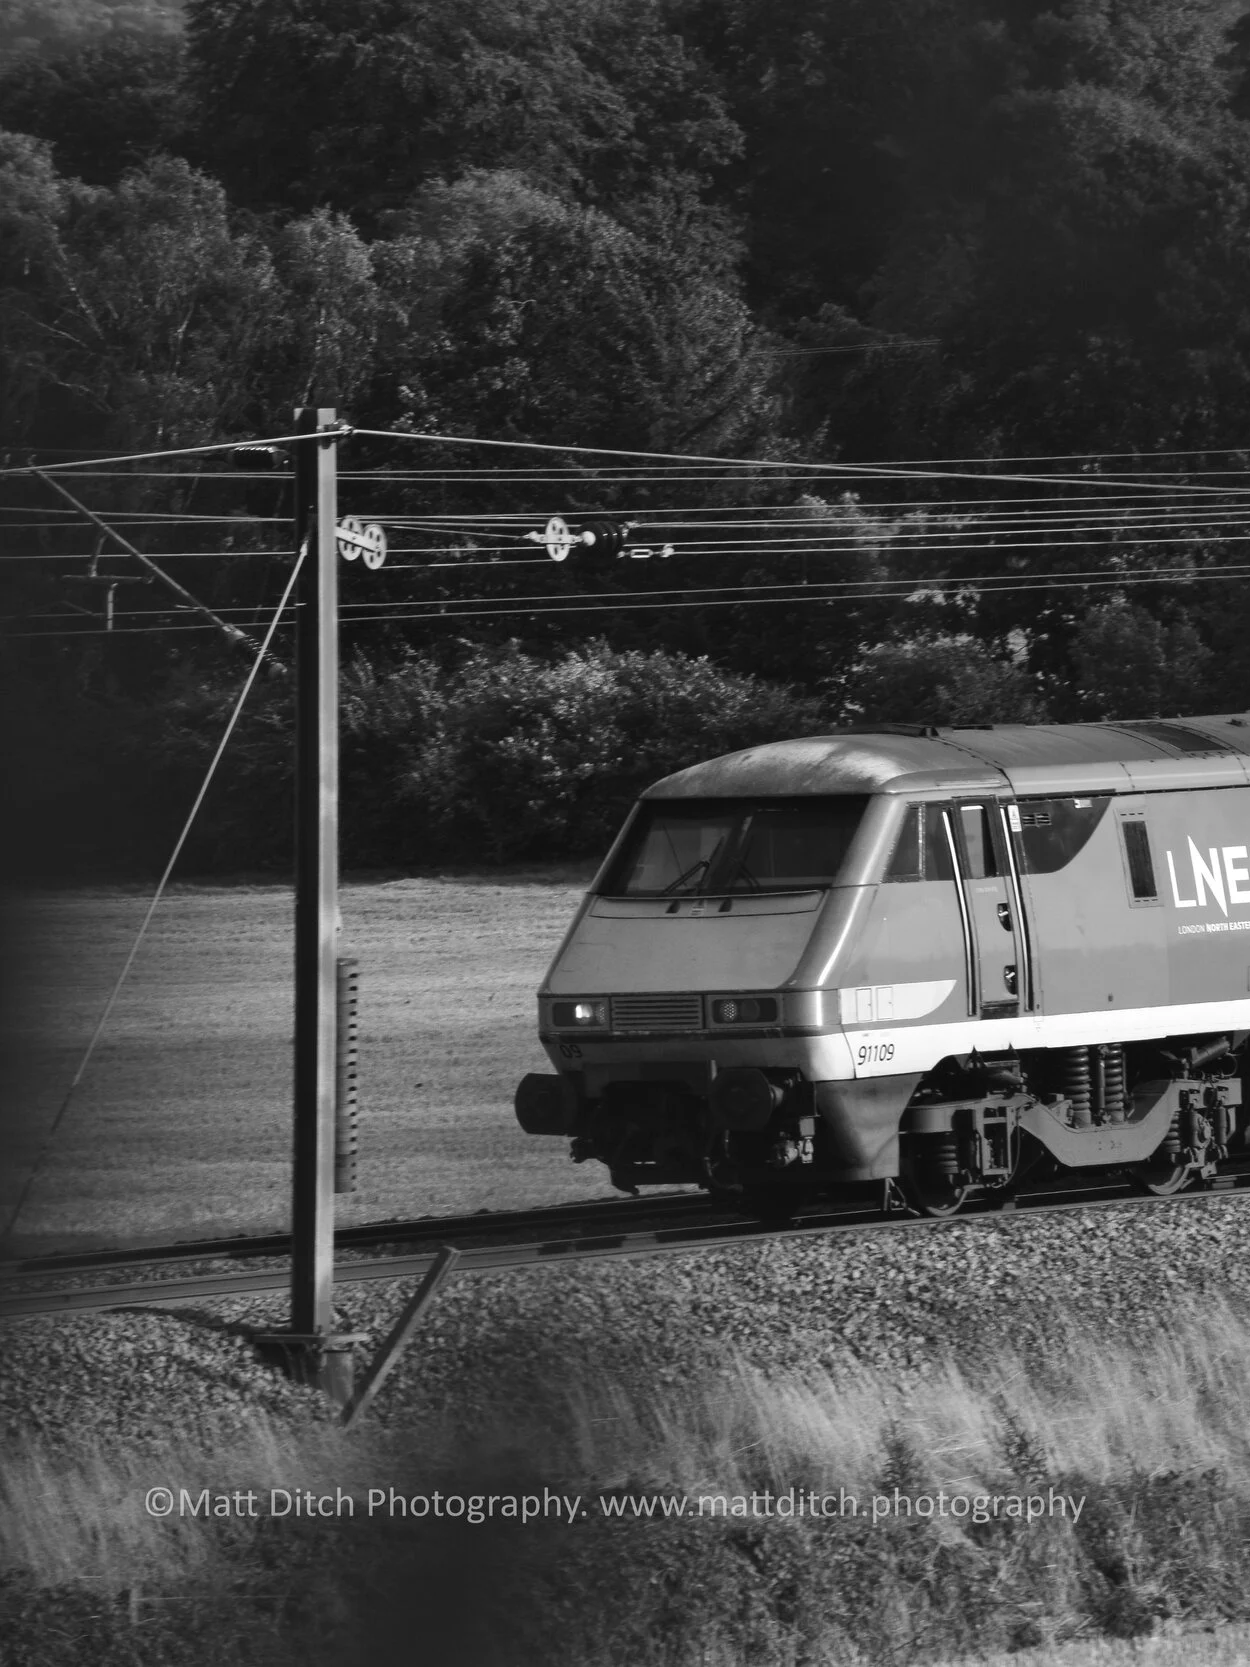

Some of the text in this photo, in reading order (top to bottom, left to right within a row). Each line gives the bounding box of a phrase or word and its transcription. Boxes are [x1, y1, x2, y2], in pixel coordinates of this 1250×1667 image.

[1178, 924, 1205, 935] LONDON
[1205, 922, 1229, 933] NORTH
[559, 1044, 583, 1059] 09
[857, 1043, 895, 1066] 91109
